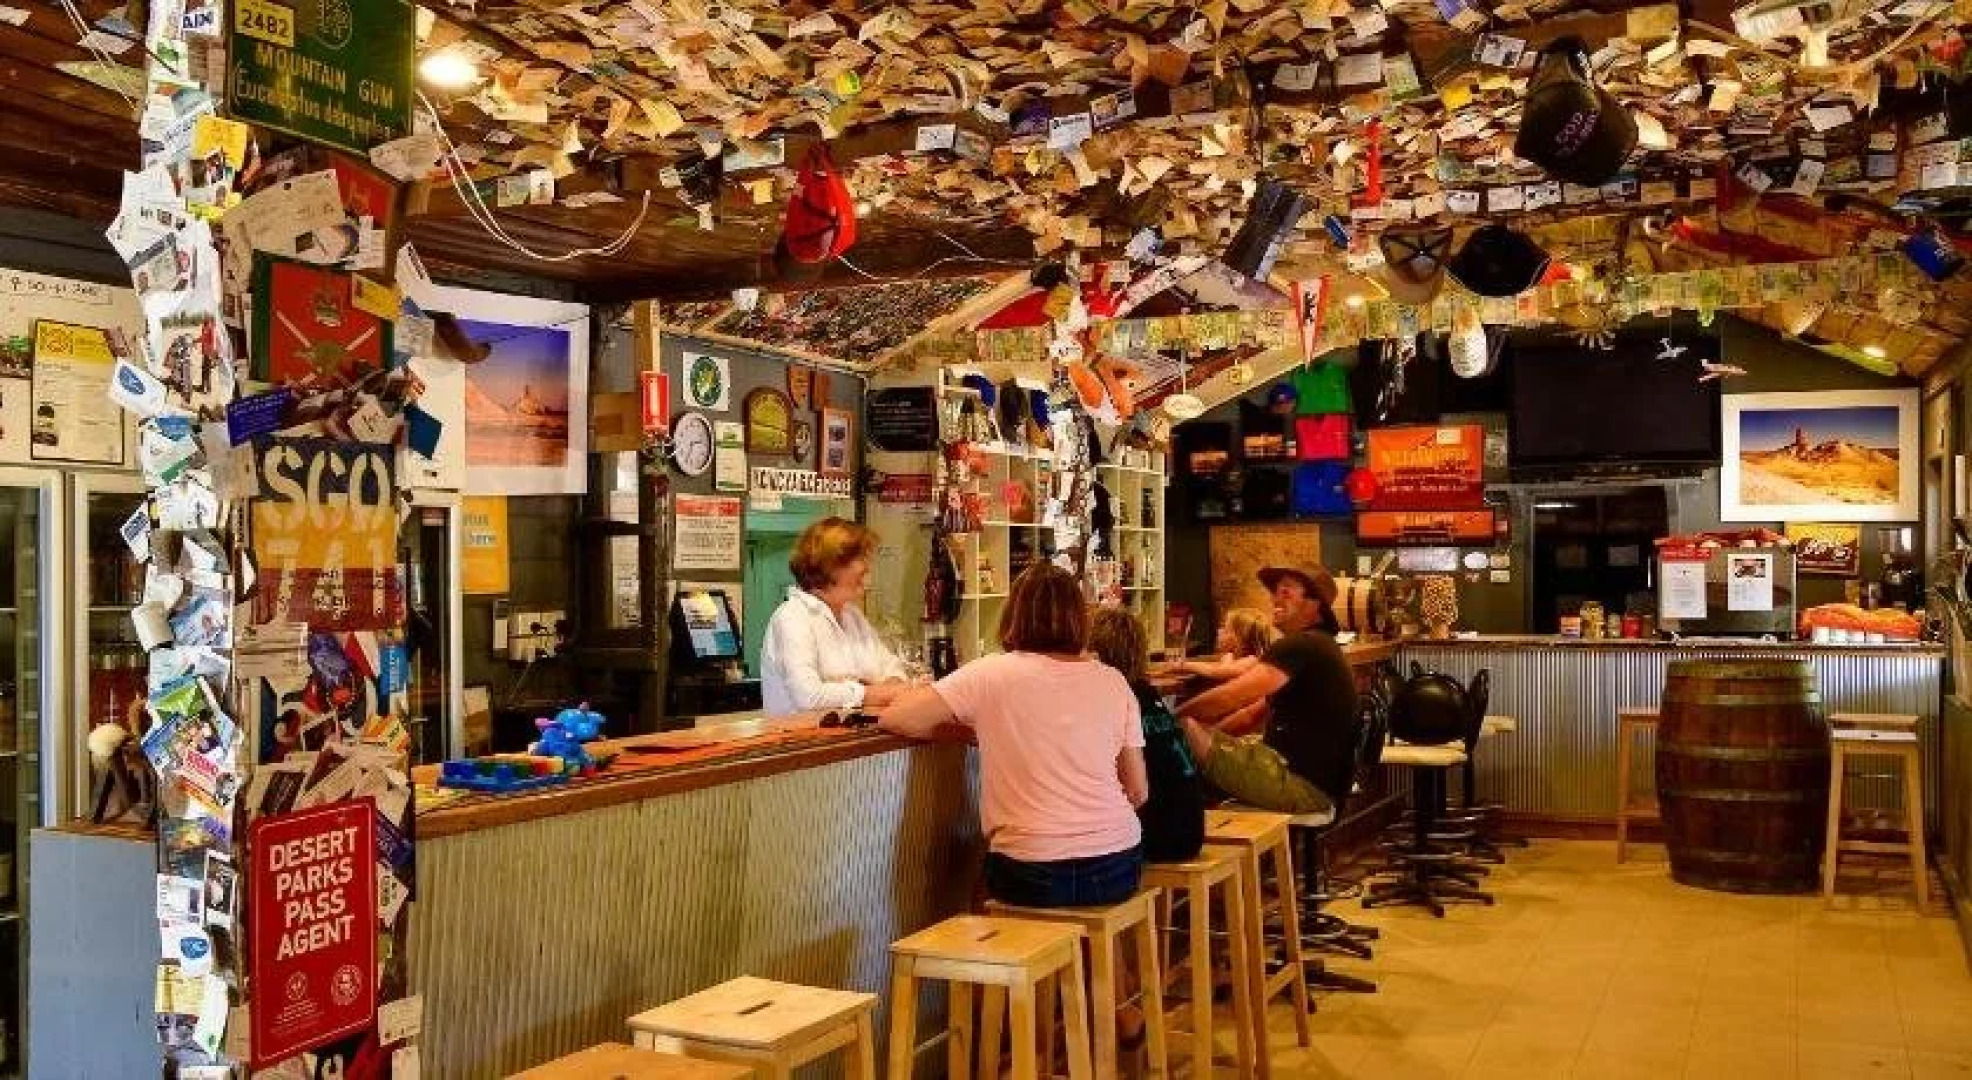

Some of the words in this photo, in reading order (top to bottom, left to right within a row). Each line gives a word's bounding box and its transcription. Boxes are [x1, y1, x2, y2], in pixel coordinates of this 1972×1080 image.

[241, 8, 289, 38] 2482
[256, 41, 346, 95] MOUNTAIN
[358, 79, 393, 109] GUM
[265, 445, 391, 532] SGO
[269, 827, 359, 872] DESERT
[276, 857, 353, 901] PARKS
[285, 888, 346, 929] PASS
[276, 915, 355, 961] AGENT
